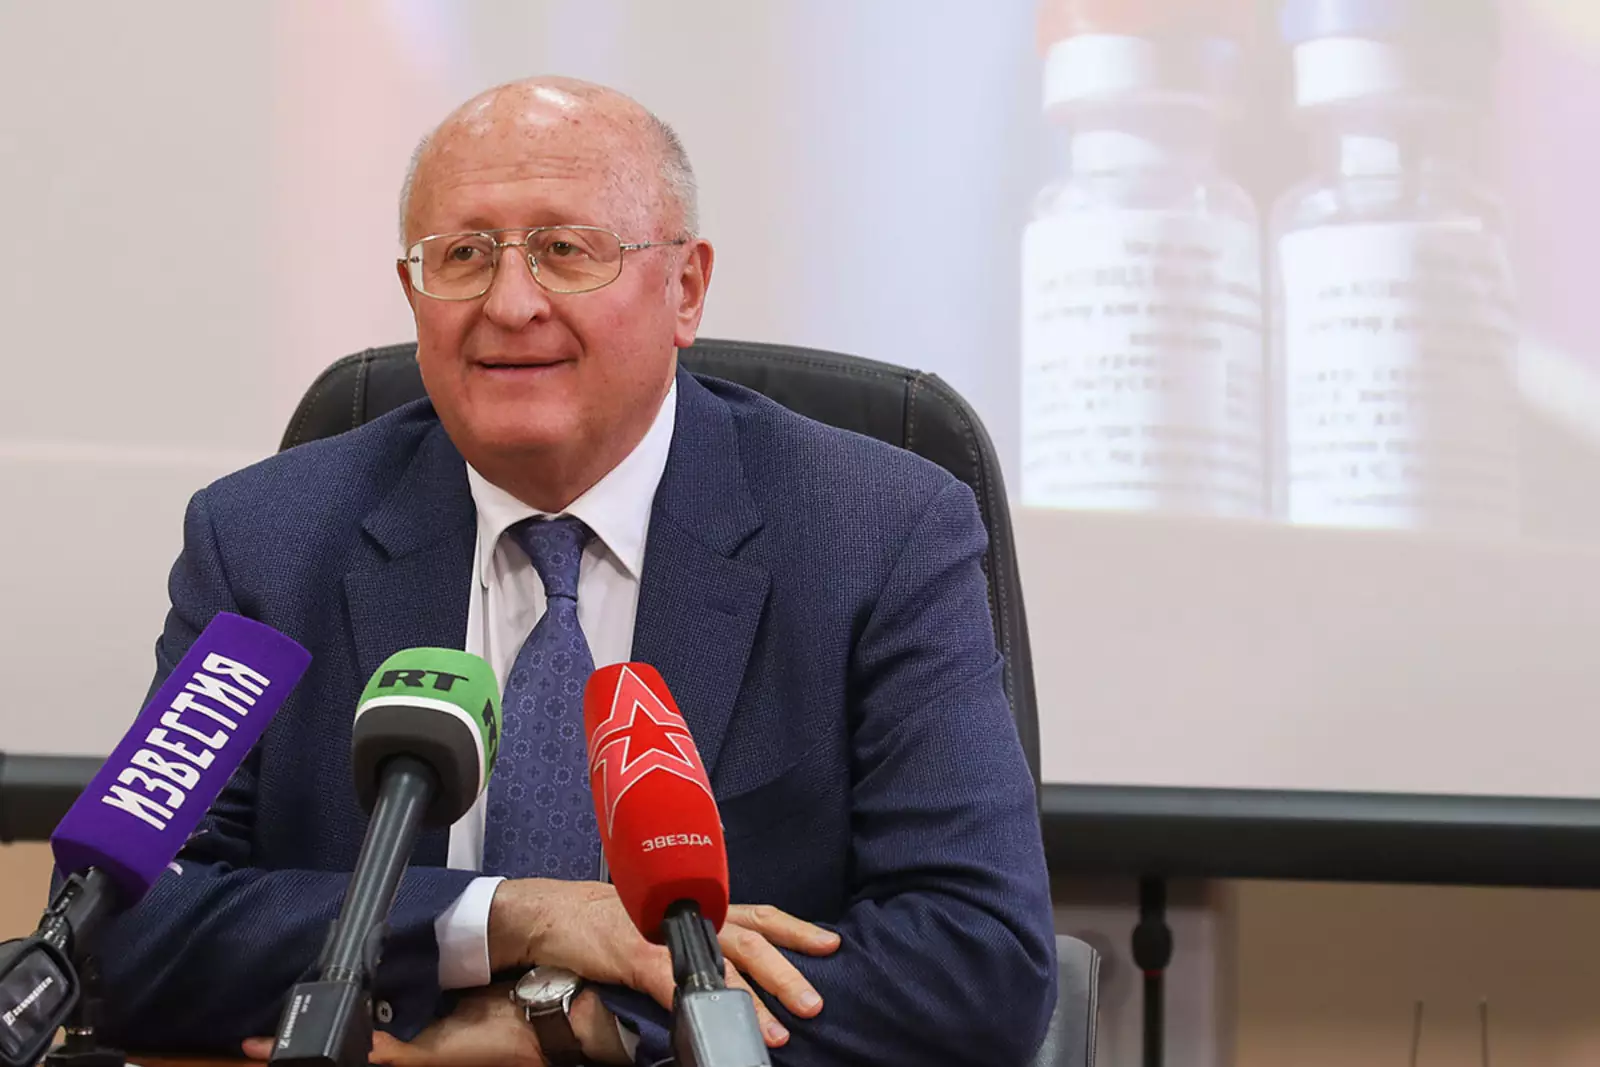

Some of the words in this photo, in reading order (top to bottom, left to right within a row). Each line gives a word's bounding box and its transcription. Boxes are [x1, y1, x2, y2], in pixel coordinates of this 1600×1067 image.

[377, 669, 469, 692] RT
[101, 652, 271, 831] ИЗВЕСТИЯ
[641, 834, 712, 852] ЗВЕЗДА
